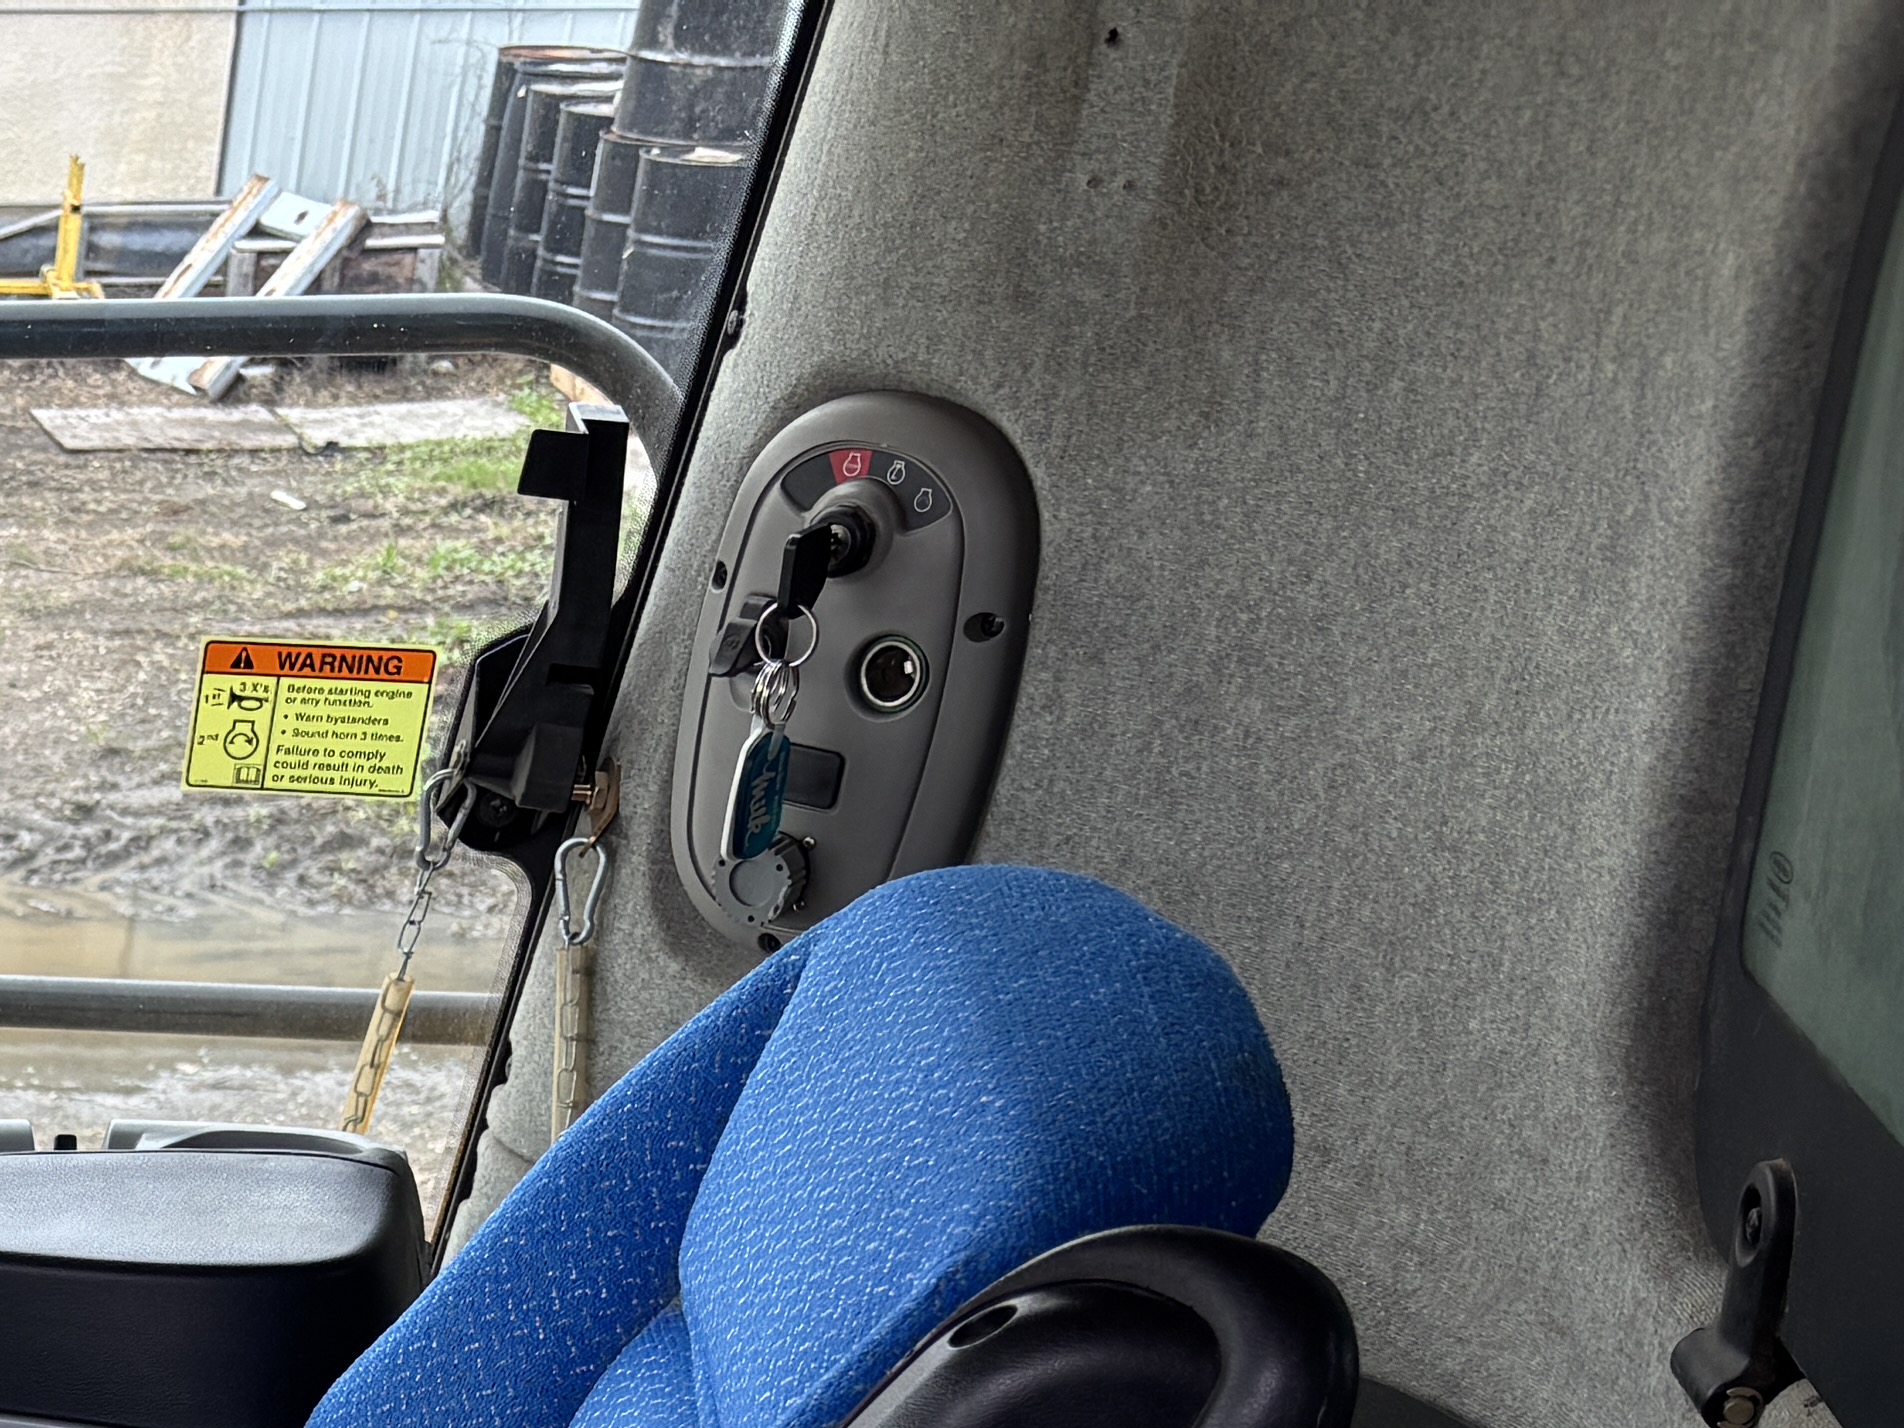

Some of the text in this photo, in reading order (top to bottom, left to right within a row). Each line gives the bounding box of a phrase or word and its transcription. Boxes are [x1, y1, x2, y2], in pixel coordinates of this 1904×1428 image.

[277, 651, 403, 676] WARNING
[239, 681, 247, 692] 3
[287, 684, 413, 700] Before starting engine
[285, 697, 297, 705] or
[300, 697, 320, 708] any
[295, 712, 389, 726] Warn bystanders
[292, 728, 404, 743] Sound horn 3 times.
[276, 745, 386, 763] Failure to comply
[273, 760, 404, 775] could result in death
[272, 774, 379, 789] or serious injury.
